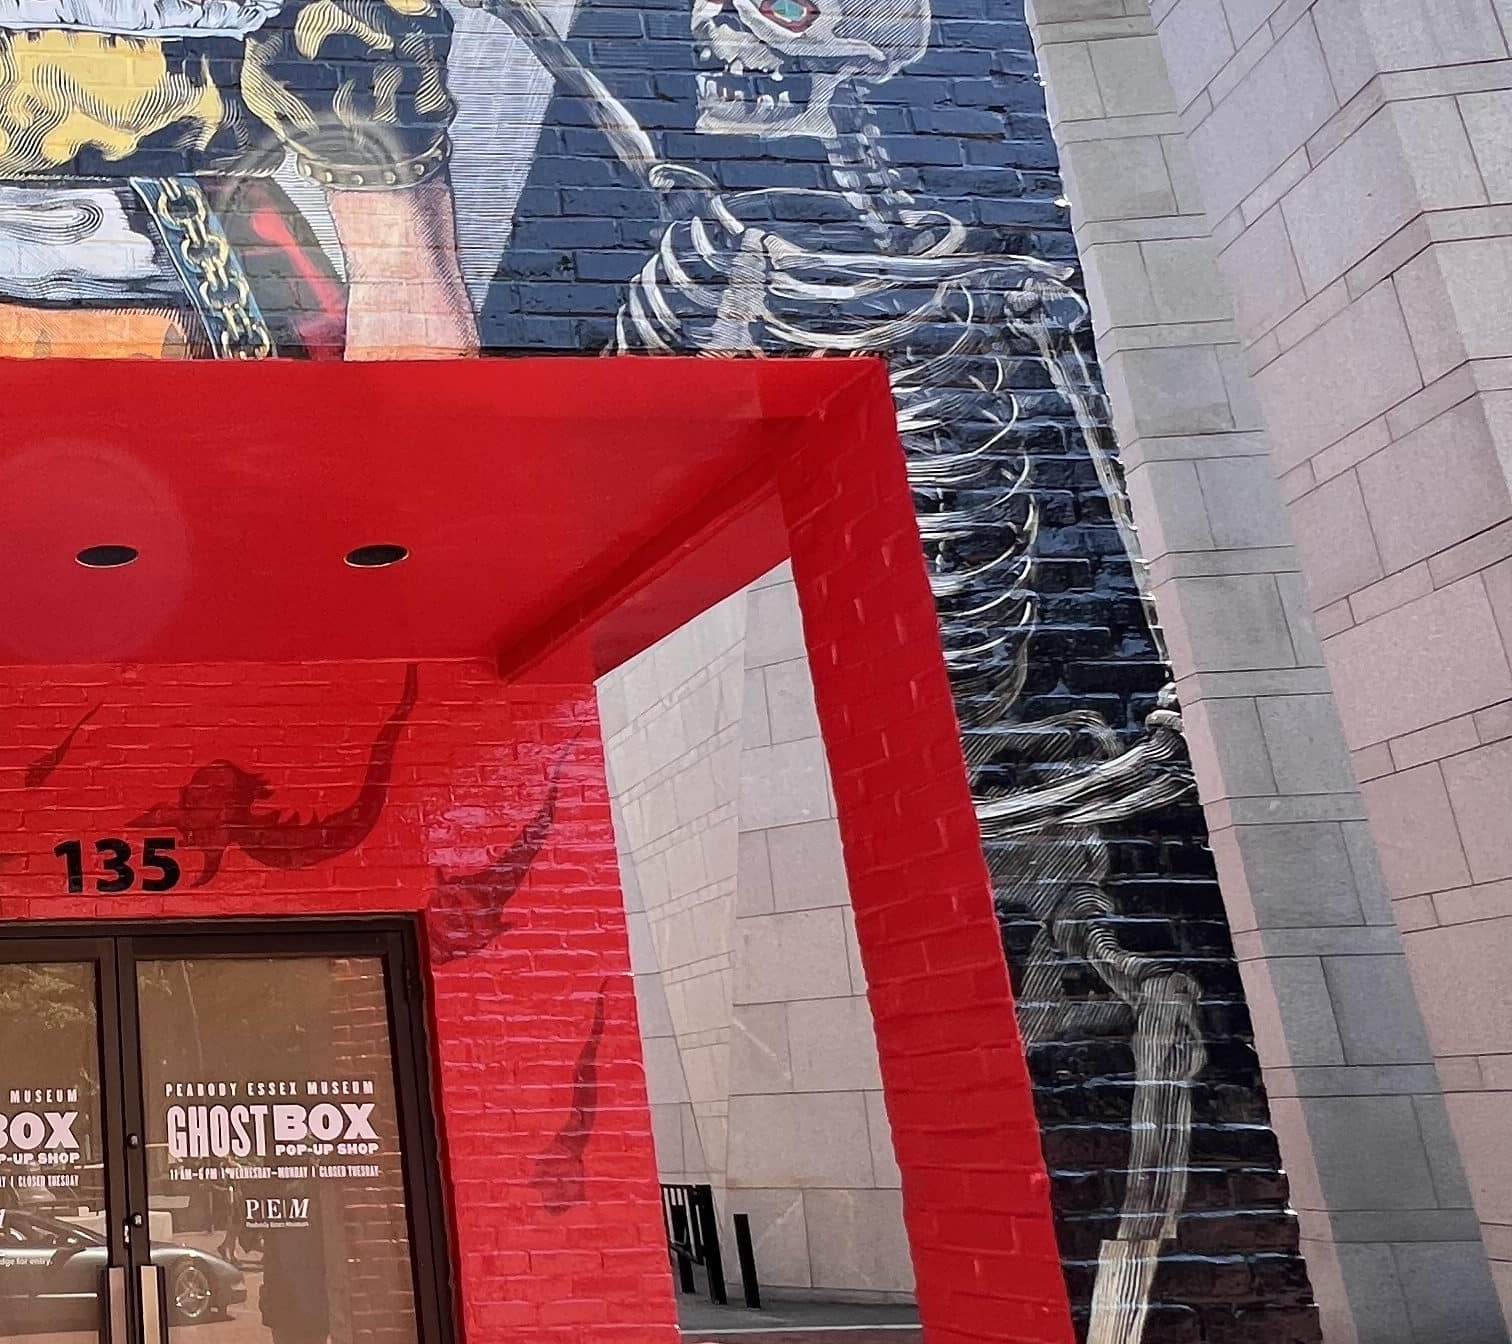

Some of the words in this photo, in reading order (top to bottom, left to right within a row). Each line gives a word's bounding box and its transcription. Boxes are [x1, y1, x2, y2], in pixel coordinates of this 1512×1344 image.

[53, 837, 182, 894] 135
[165, 1082, 237, 1097] PEABODY
[248, 1081, 298, 1096] ESSEX
[307, 1080, 375, 1096] MUSEUM
[10, 1088, 79, 1104] MUSEUM
[167, 1104, 269, 1159] GHOST
[273, 1103, 379, 1142] BOX
[275, 1143, 334, 1156] POP-UP
[337, 1142, 379, 1155] SHOP
[37, 1152, 80, 1165] SHOP
[319, 1165, 346, 1178] CLOSED
[348, 1165, 379, 1177] TUESDAY
[17, 1174, 46, 1188] CLOSED
[47, 1174, 79, 1187] TUESDAY
[16, 1256, 28, 1266] for
